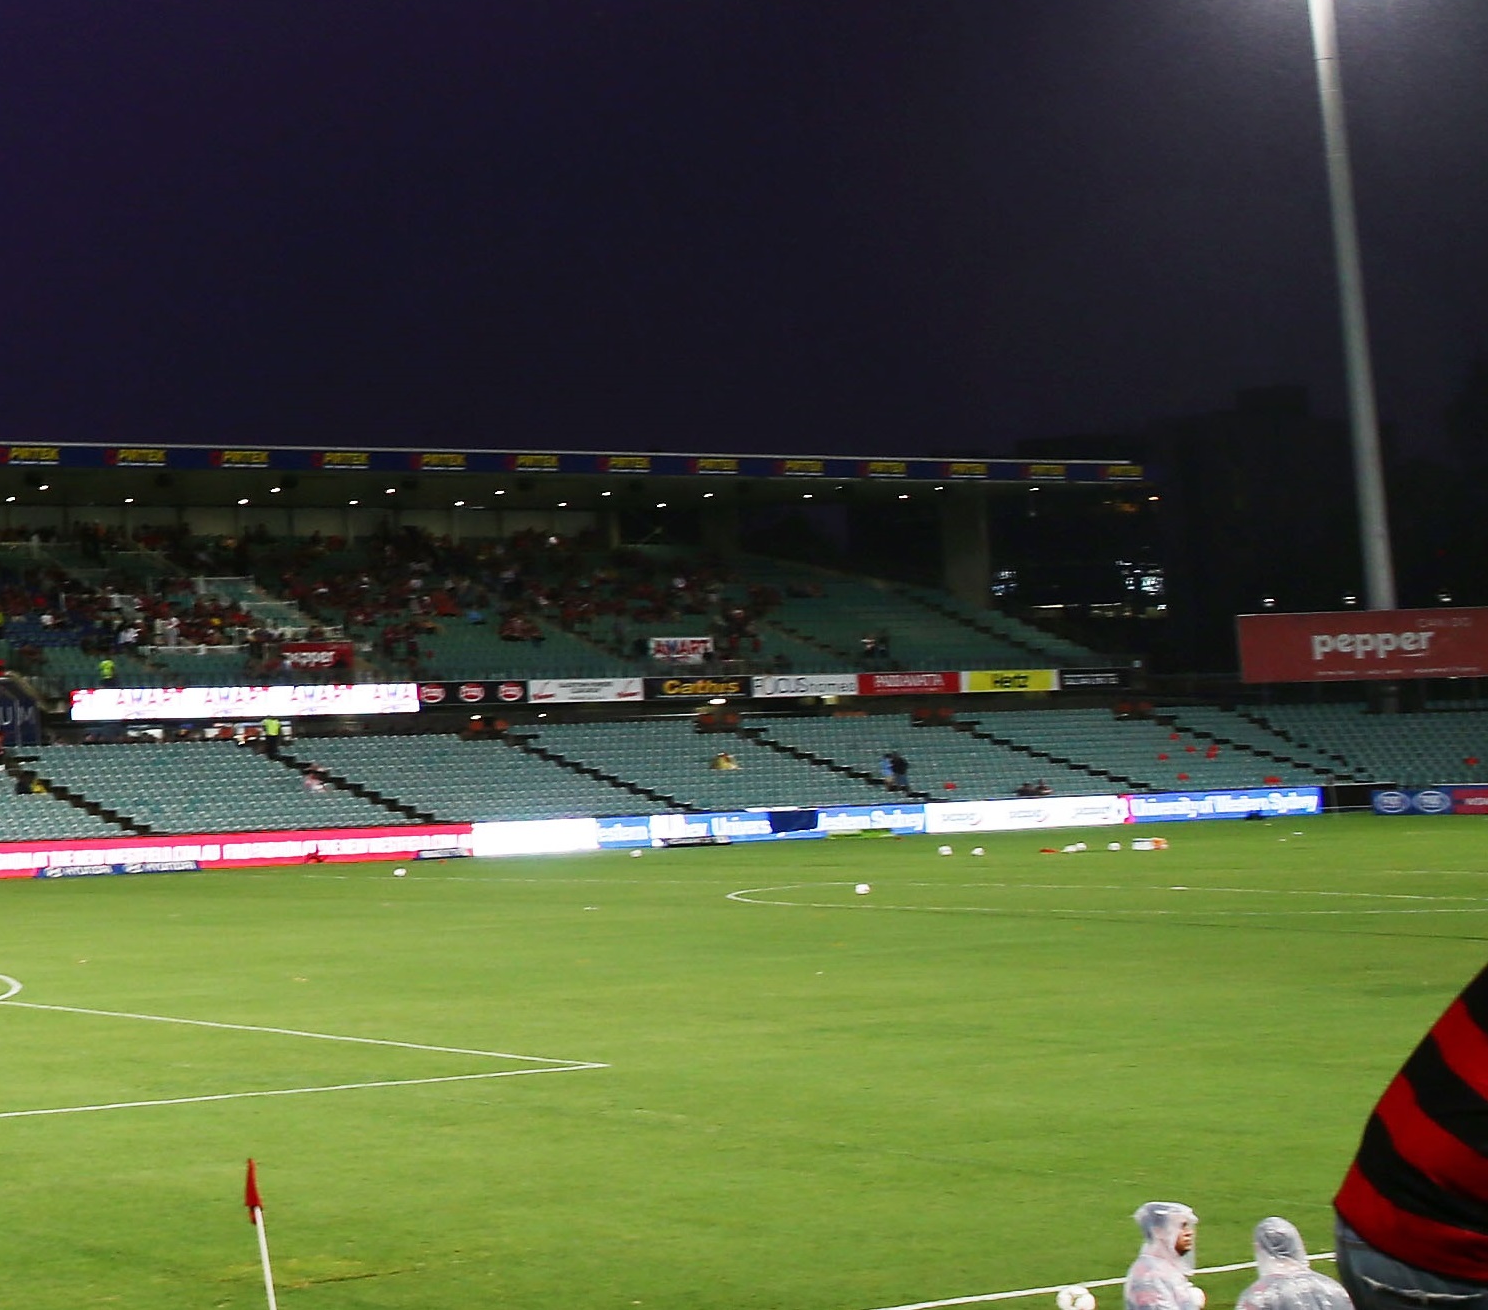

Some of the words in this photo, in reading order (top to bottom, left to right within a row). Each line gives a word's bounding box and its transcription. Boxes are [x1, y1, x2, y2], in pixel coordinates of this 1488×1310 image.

[1310, 631, 1435, 660] pepper
[1130, 797, 1199, 817] University
[1269, 792, 1318, 812] Sydney
[871, 810, 925, 830] Sydney
